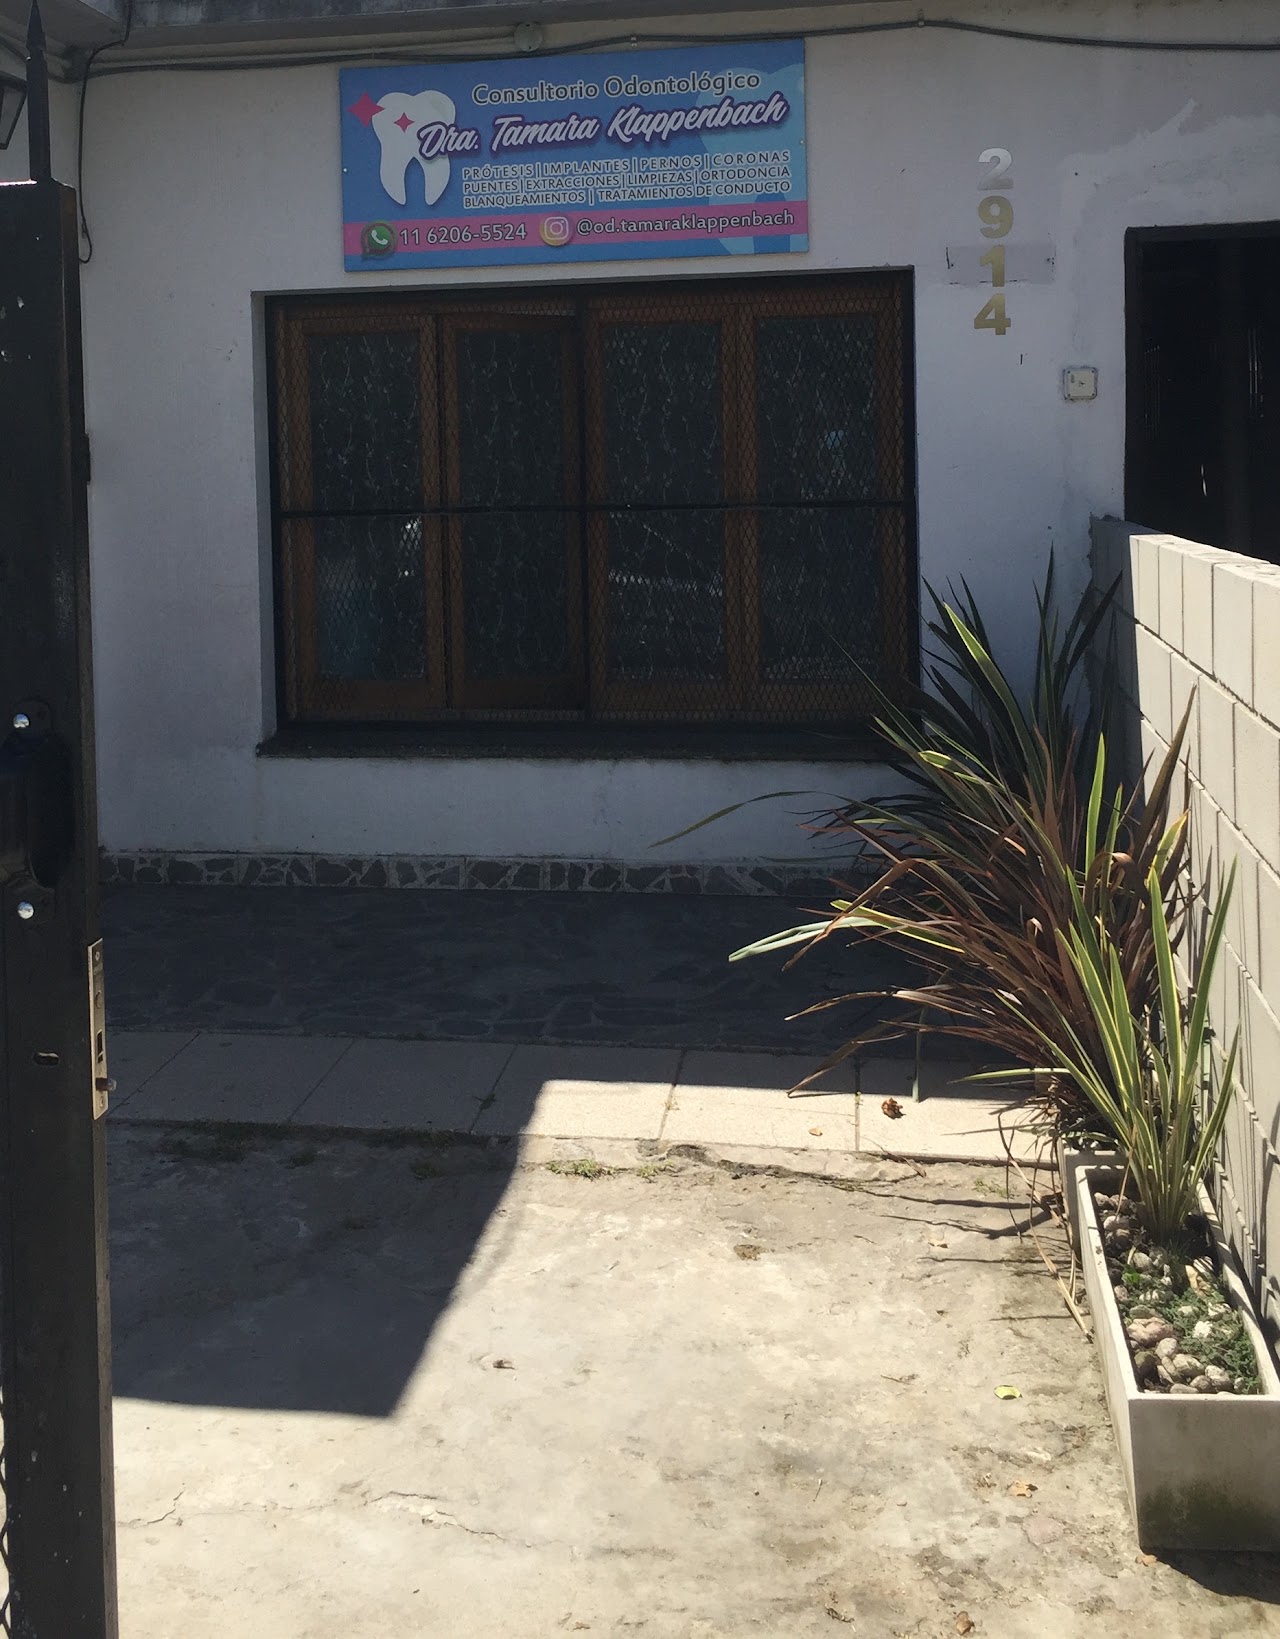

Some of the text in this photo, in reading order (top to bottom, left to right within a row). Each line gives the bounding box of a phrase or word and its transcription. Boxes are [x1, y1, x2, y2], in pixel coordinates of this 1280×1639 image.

[473, 71, 760, 105] Consultorio Odontológico
[418, 93, 787, 157] Dra. Tamara Klappenbach
[464, 181, 790, 208] BLANQUEAMIENTOS TRATAMIENTOS DE CONDUCTO
[400, 210, 794, 246] 11 6206-5524 @od.tamaraklappenbach
